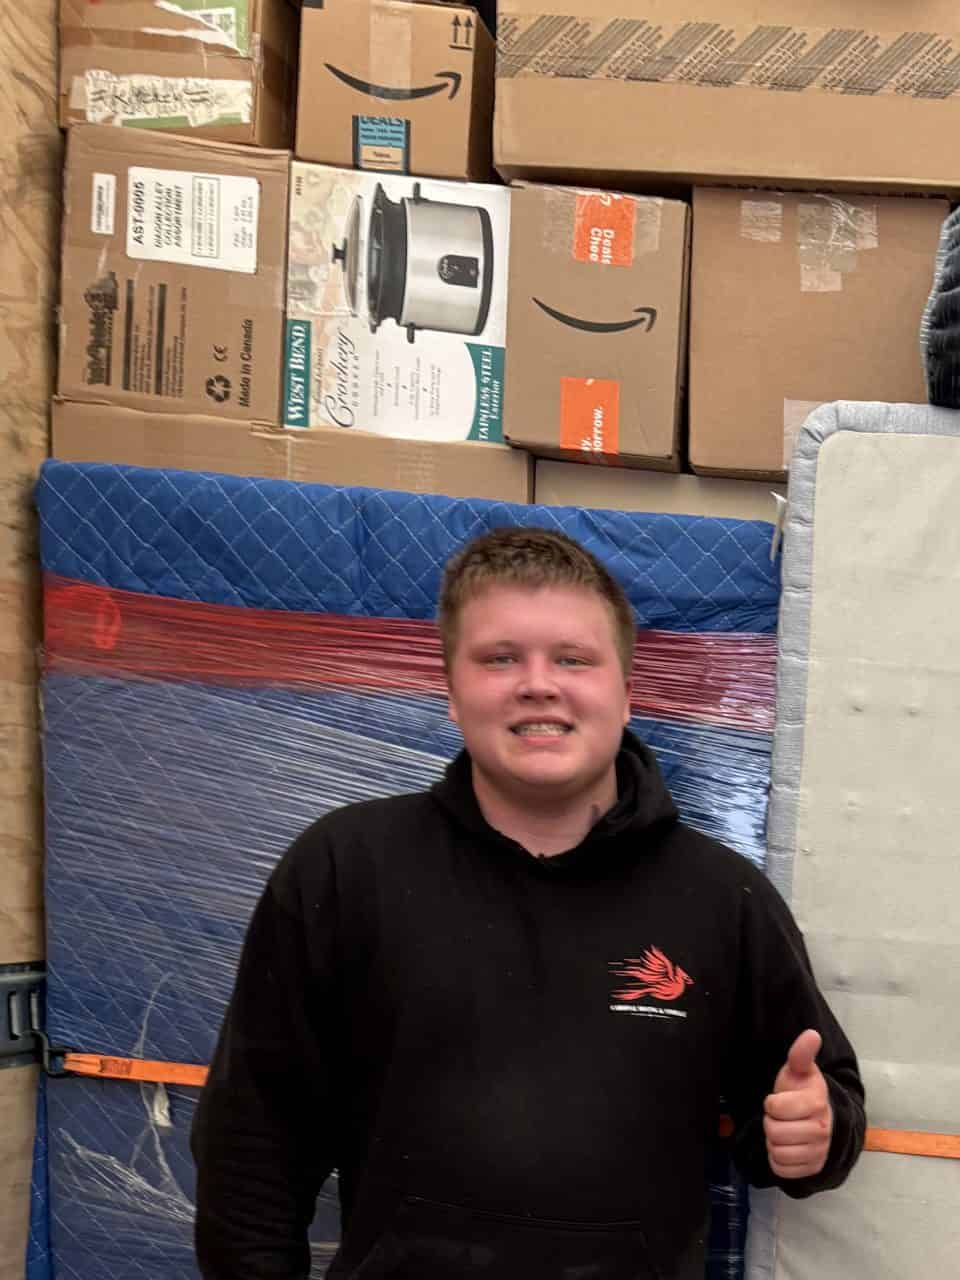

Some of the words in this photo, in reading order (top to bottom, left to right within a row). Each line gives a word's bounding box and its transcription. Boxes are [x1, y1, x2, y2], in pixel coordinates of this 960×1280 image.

[240, 319, 253, 362] Canada
[288, 325, 306, 370] BEND
[240, 363, 251, 375] in
[325, 329, 355, 428] Crockery
[239, 377, 252, 408] Made
[287, 373, 305, 421] WEST
